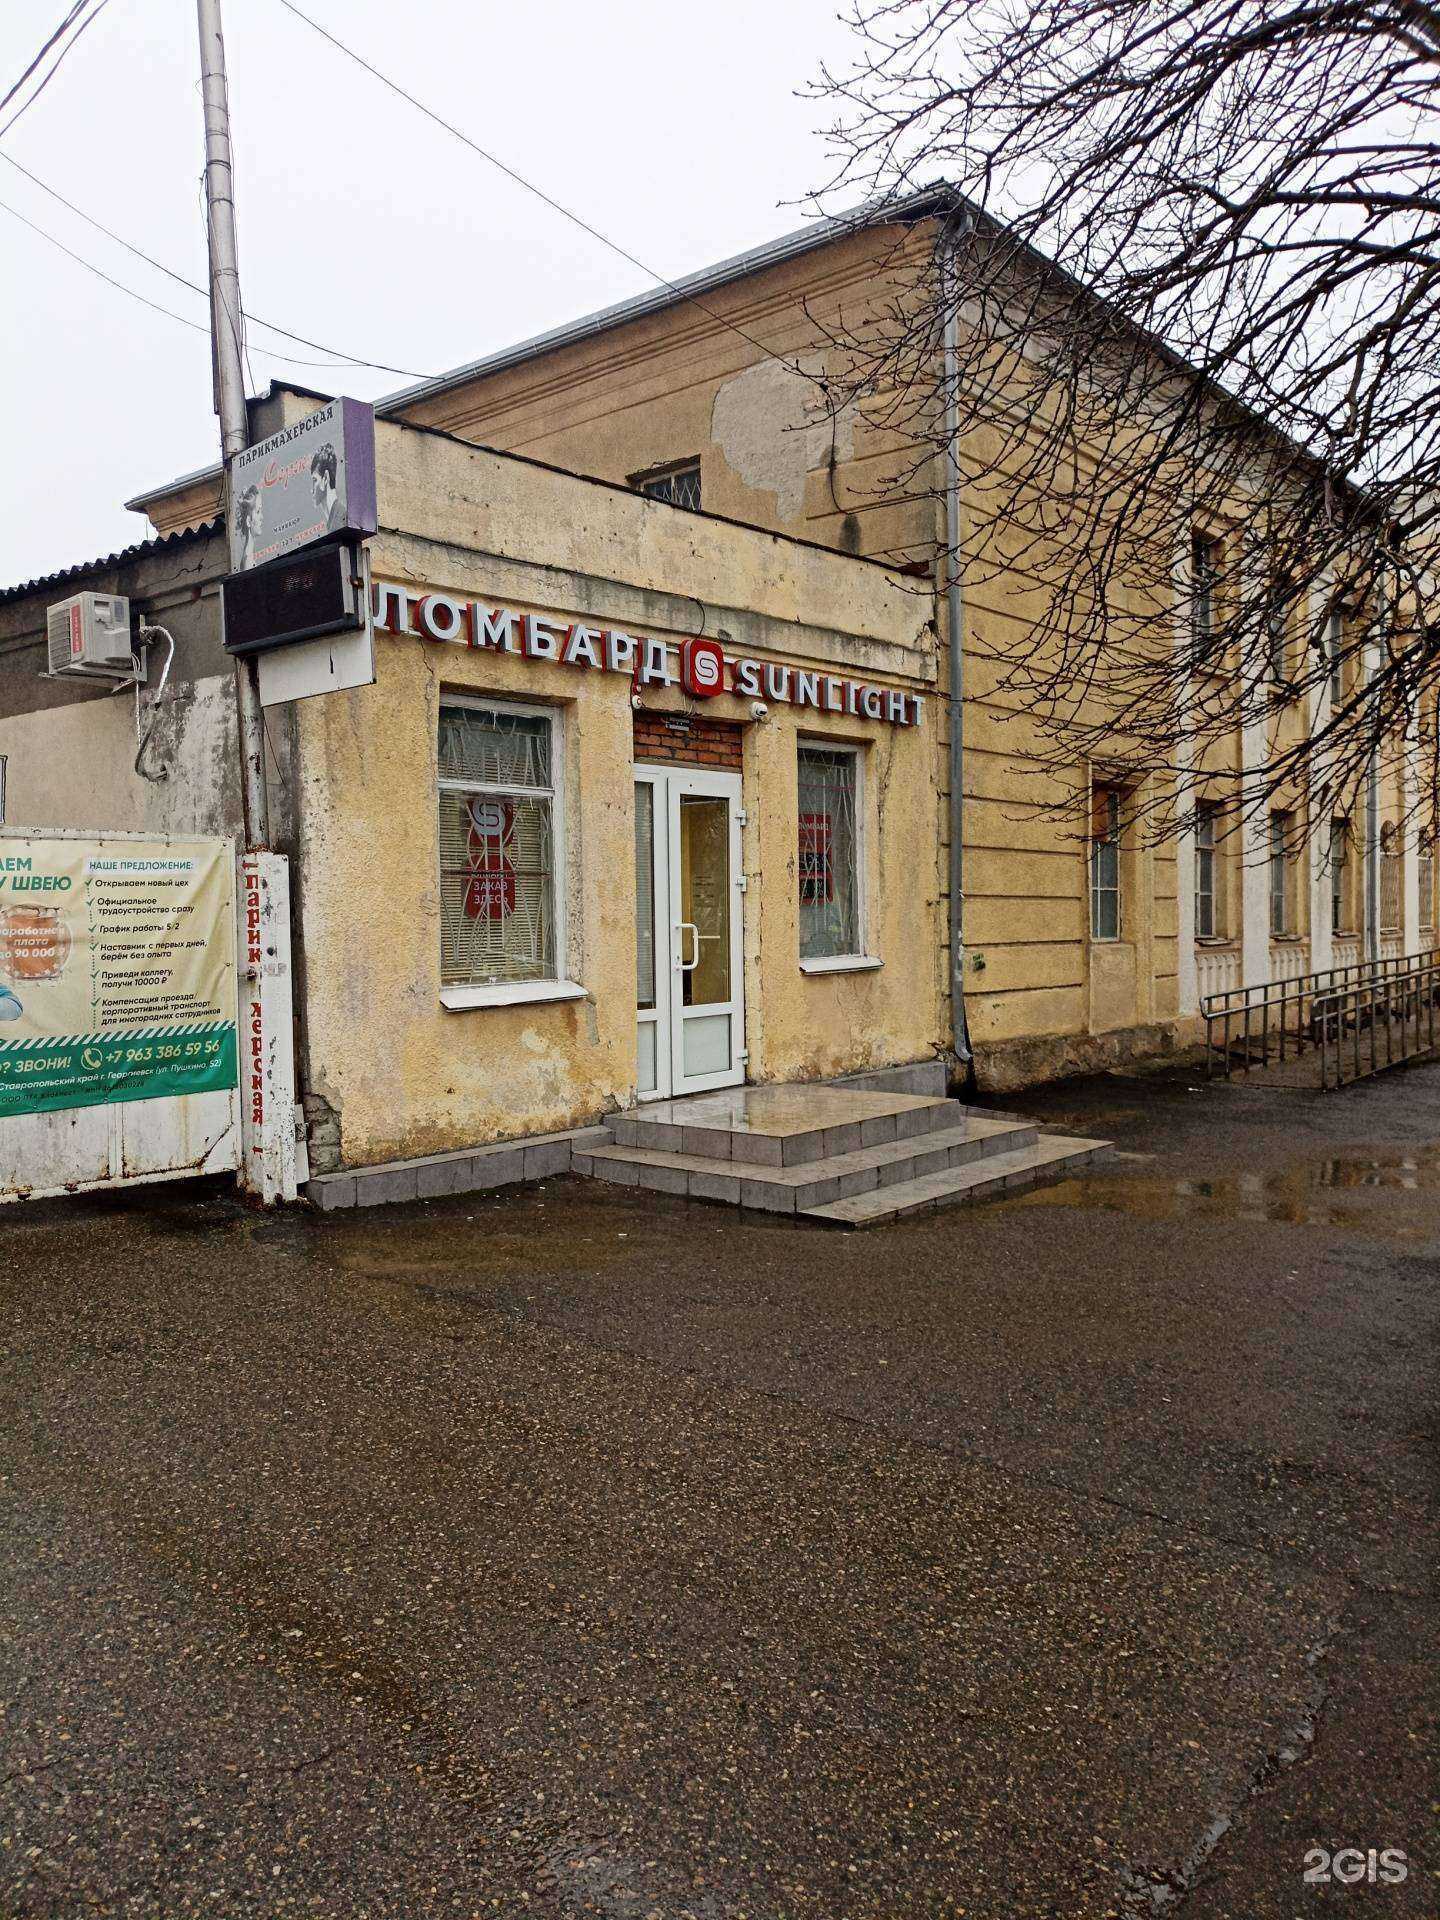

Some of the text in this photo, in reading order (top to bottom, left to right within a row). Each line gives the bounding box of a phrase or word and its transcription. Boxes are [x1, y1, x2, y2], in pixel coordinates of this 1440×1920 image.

[239, 406, 334, 468] ПАРИКМАХЕРСКАЯ
[372, 582, 672, 688] ЛОМБАРД
[734, 658, 927, 727] SUNLIGHT
[89, 861, 193, 871] НАШЕ ПРЕДЛОЖЕНИЕ:
[12, 876, 72, 891] ШВЕЮ
[95, 879, 189, 888] Открываем новый цех
[97, 898, 157, 906] Официальное
[98, 907, 170, 916] трудоустройство
[100, 923, 180, 934] График работы 5/2
[100, 943, 146, 952] Наставник
[156, 942, 185, 950] первых
[147, 951, 172, 959] опыта
[102, 971, 139, 980] Приведи
[102, 980, 133, 989] получи
[135, 978, 160, 987] 10000
[102, 997, 159, 1007] Компенсация
[102, 1000, 211, 1015] корпоративный транспорт
[101, 1008, 221, 1026] для иногородних сотрудников
[106, 1039, 220, 1064] +7 963 386 59 56
[15, 1056, 71, 1073] ЗВОНИ!
[0, 1076, 76, 1091] Ставропольский
[78, 1074, 100, 1084] край
[108, 1068, 153, 1080] Георгиевск
